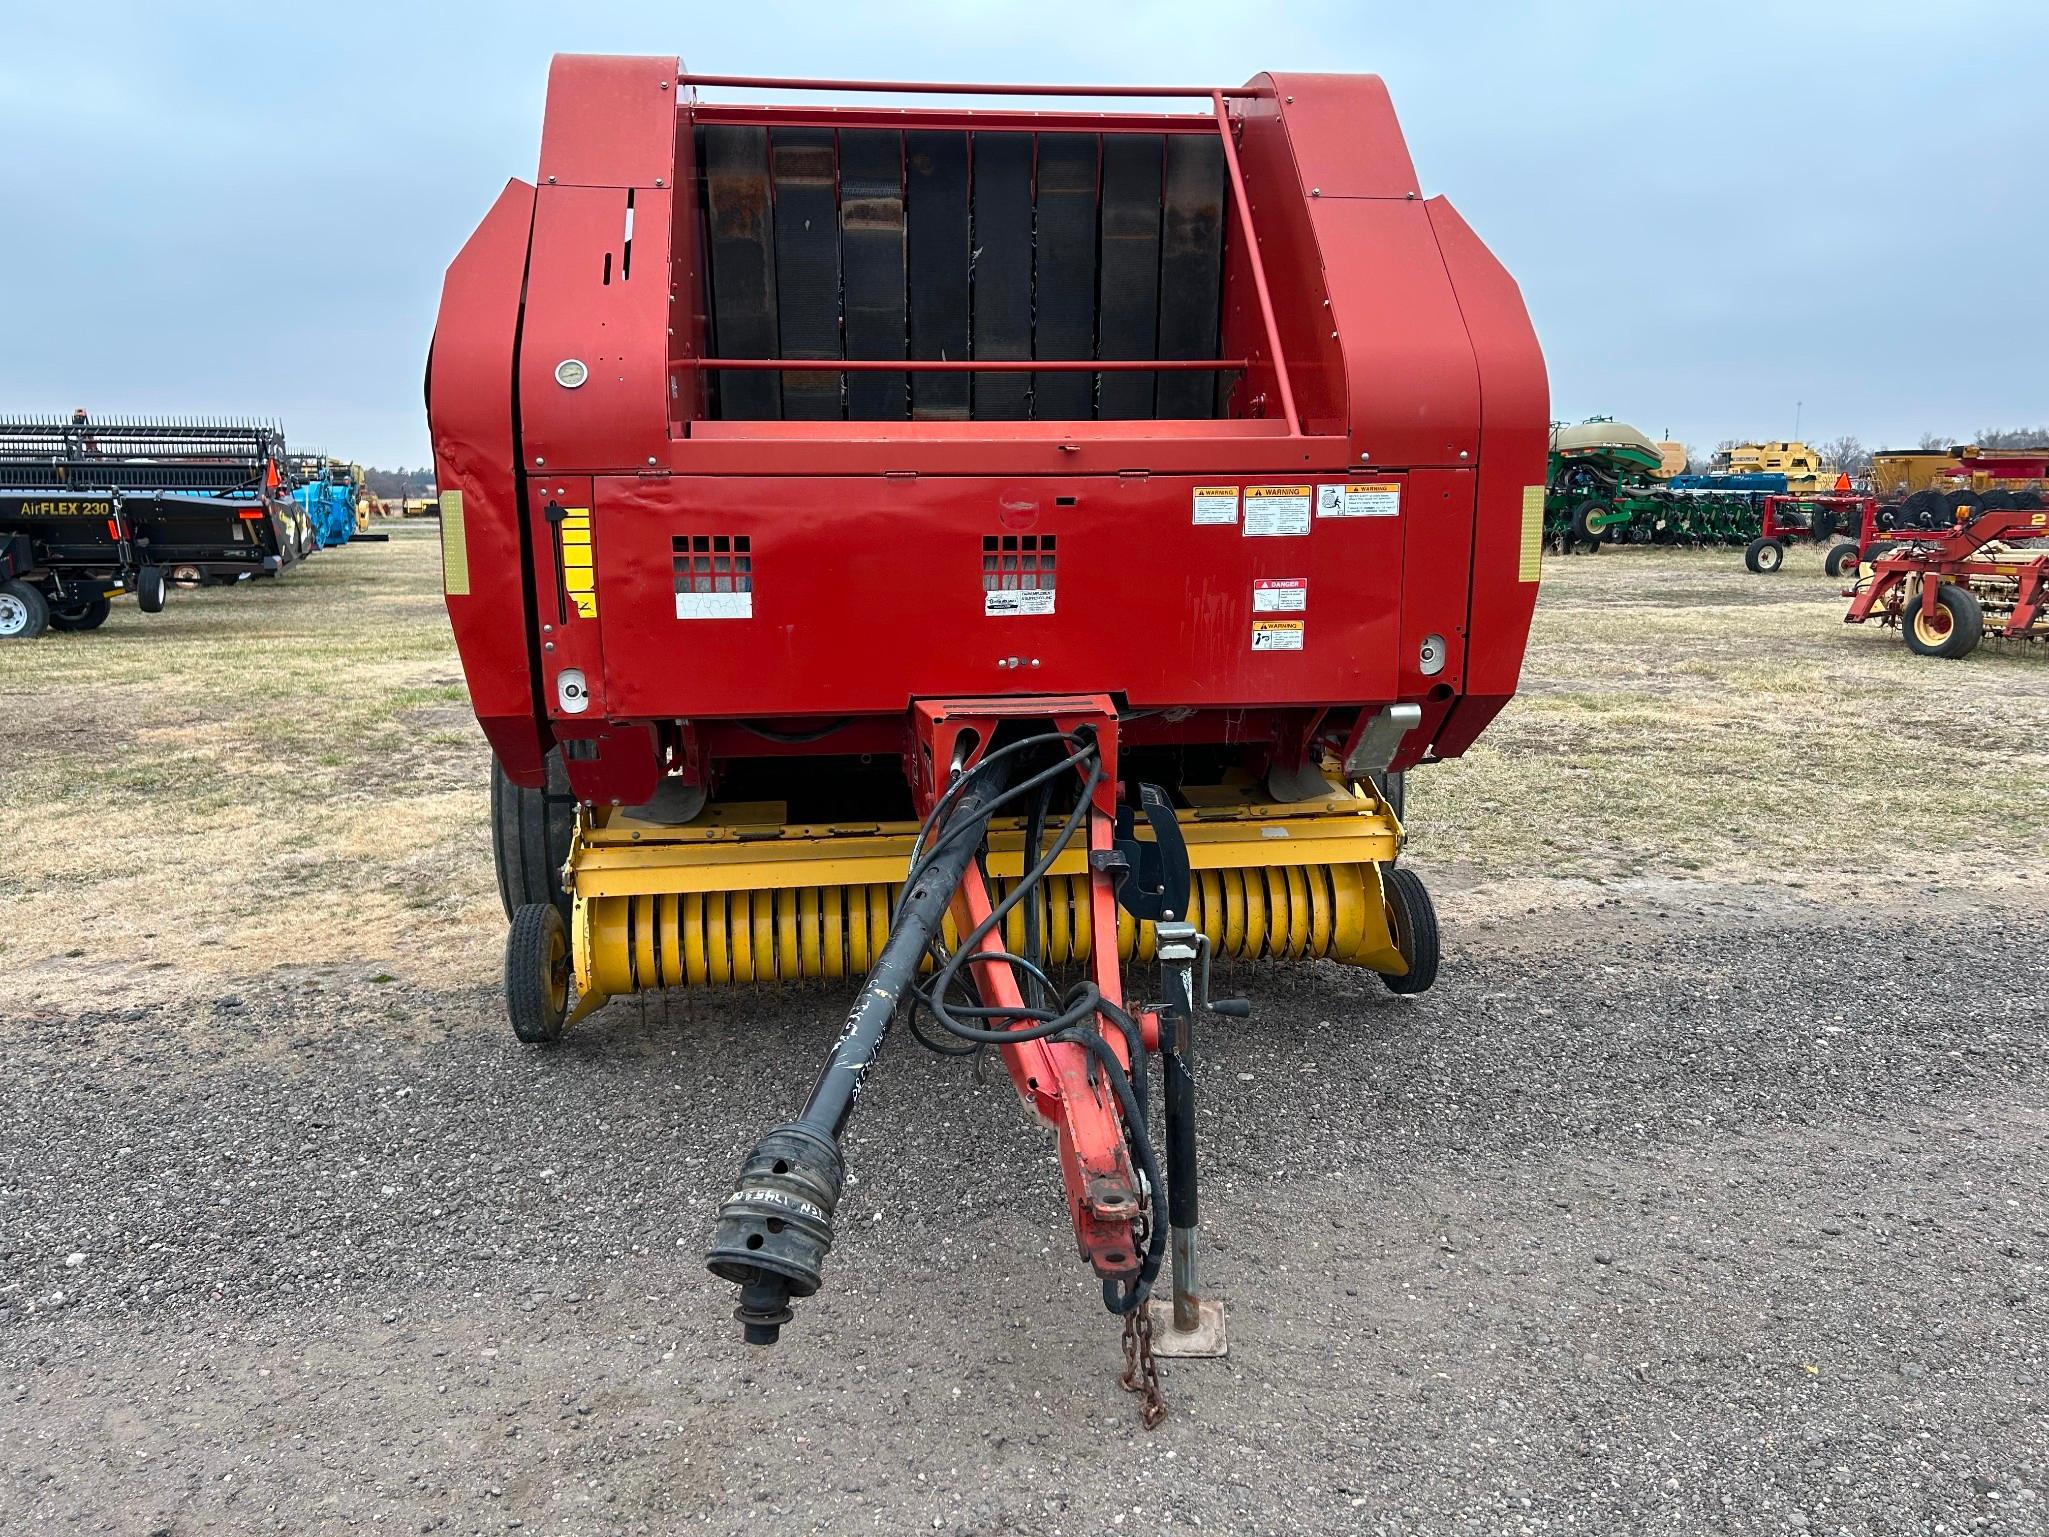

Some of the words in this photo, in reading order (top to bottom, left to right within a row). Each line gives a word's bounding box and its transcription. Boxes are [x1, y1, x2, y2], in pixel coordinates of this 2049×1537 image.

[21, 502, 78, 515] AirFLEX
[82, 502, 109, 515] 230
[2031, 513, 2047, 526] 2
